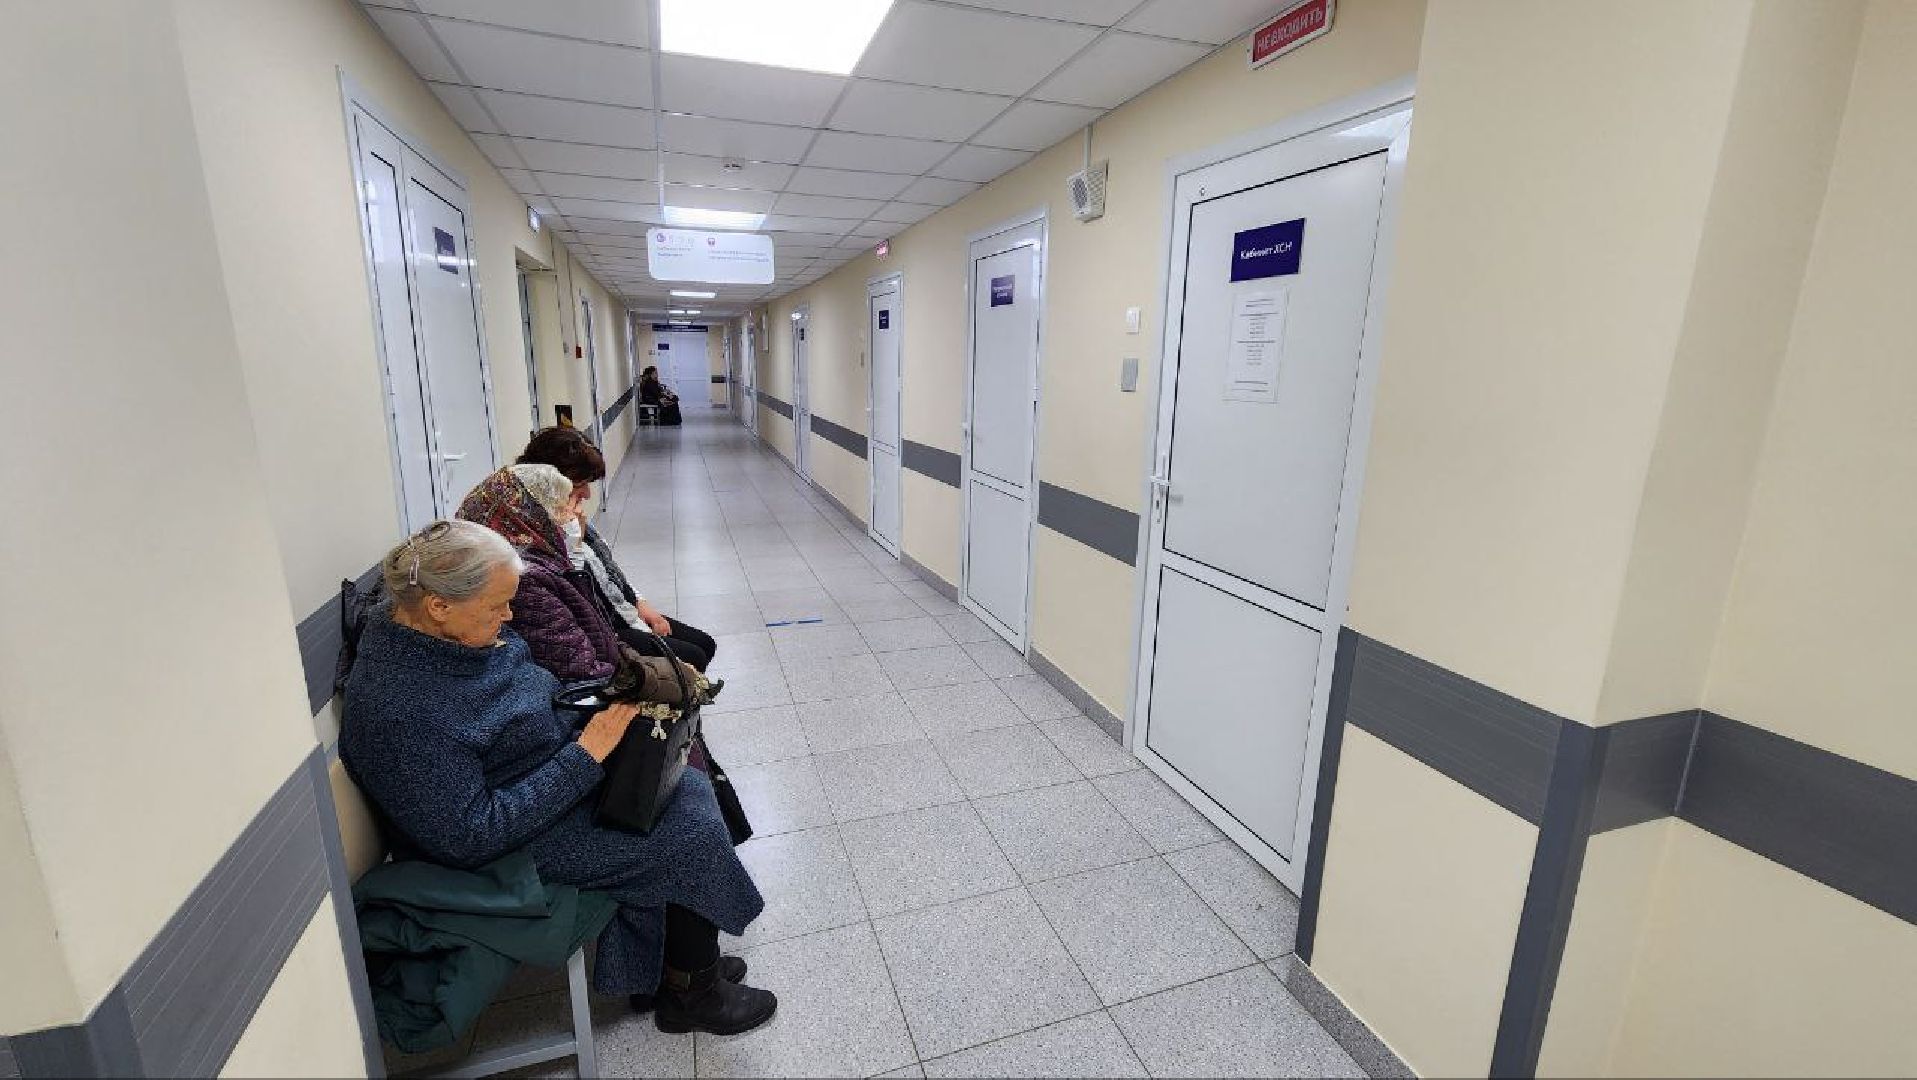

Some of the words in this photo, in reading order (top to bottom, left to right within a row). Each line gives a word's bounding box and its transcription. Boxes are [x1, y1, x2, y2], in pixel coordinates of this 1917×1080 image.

[1257, 34, 1270, 54] НЕ
[1270, 7, 1323, 47] ВХОДИТЬ
[1240, 247, 1273, 260] Кабинет
